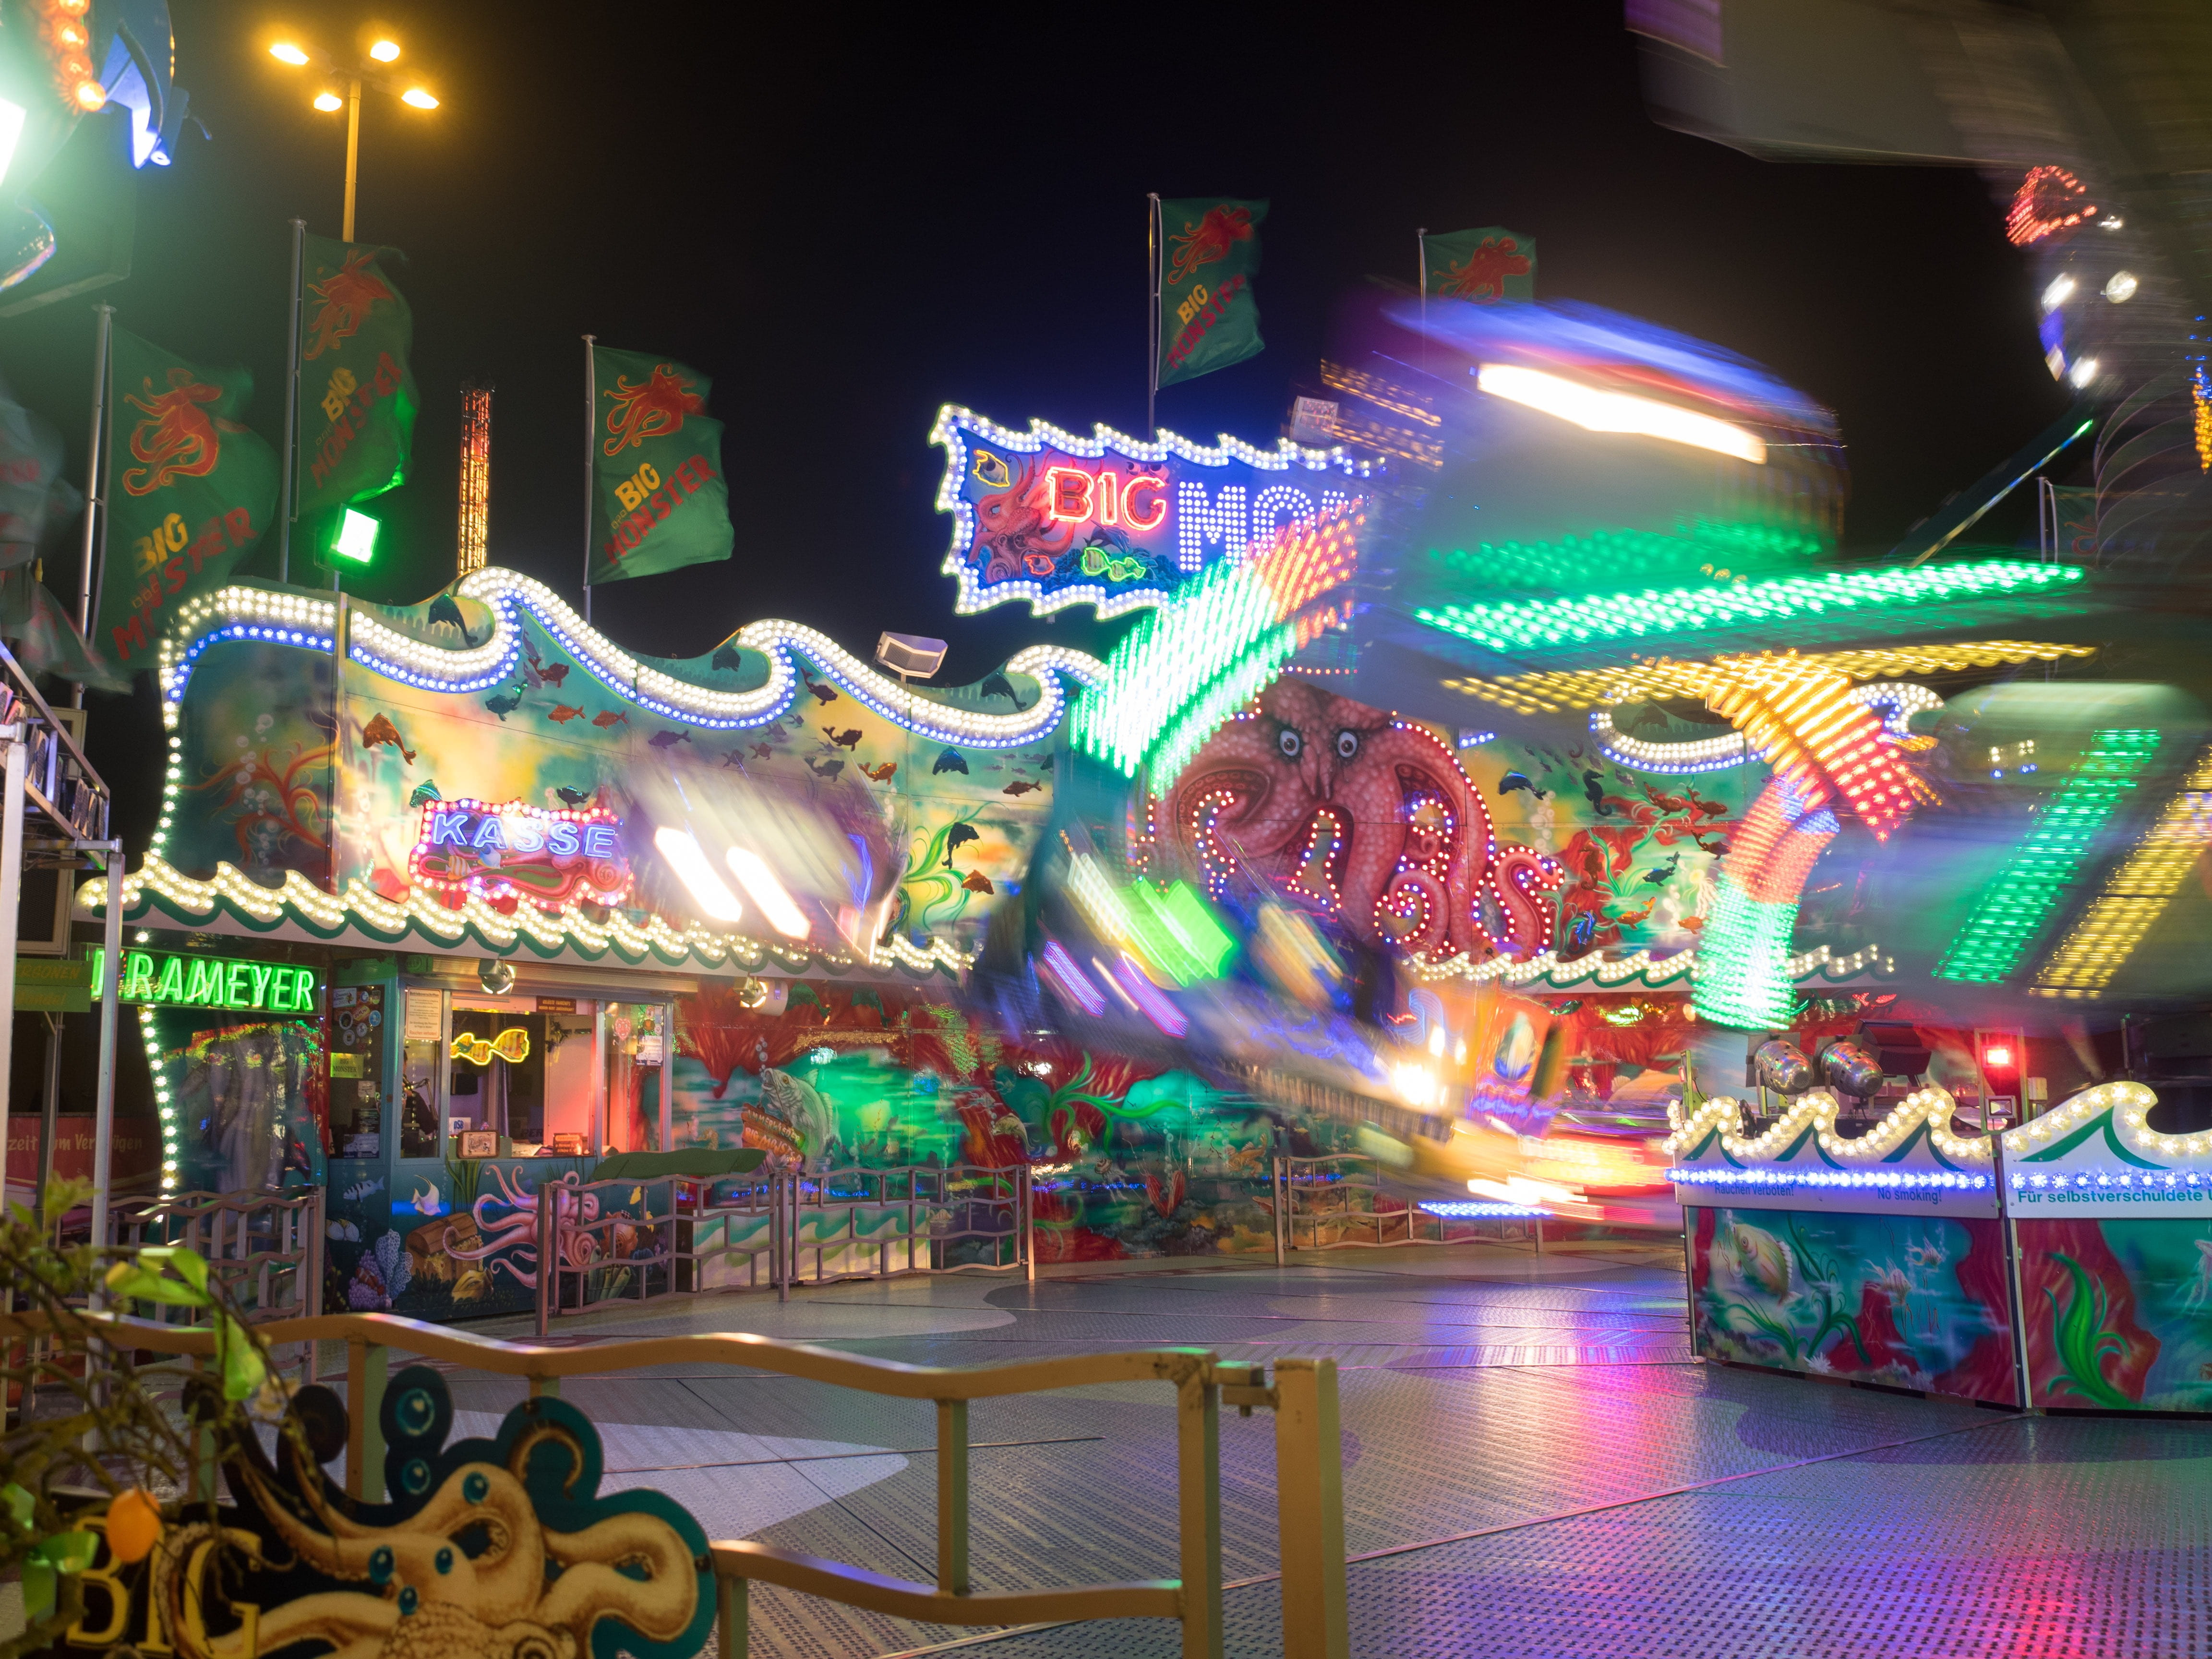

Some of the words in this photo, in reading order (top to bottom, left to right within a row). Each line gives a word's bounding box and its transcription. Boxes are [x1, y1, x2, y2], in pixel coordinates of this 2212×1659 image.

[1167, 274, 1247, 369] MONSTER
[1177, 284, 1208, 325] BIG
[320, 367, 357, 422] BIG
[604, 454, 718, 565] MONSTER
[614, 463, 661, 512] BIG
[1045, 465, 1167, 531] BIG
[1178, 481, 1351, 571] MO
[133, 512, 189, 578] BIG
[111, 506, 259, 661] MNSTER
[433, 812, 616, 859] KASSE
[1715, 1183, 1750, 1195] Rauchen
[1752, 1183, 1794, 1196] Verboten!
[1877, 1188, 1892, 1200] No
[1894, 1189, 1942, 1205] smoking!
[2018, 1190, 2043, 1202] Für
[2047, 1189, 2203, 1202] selbstverschuldete
